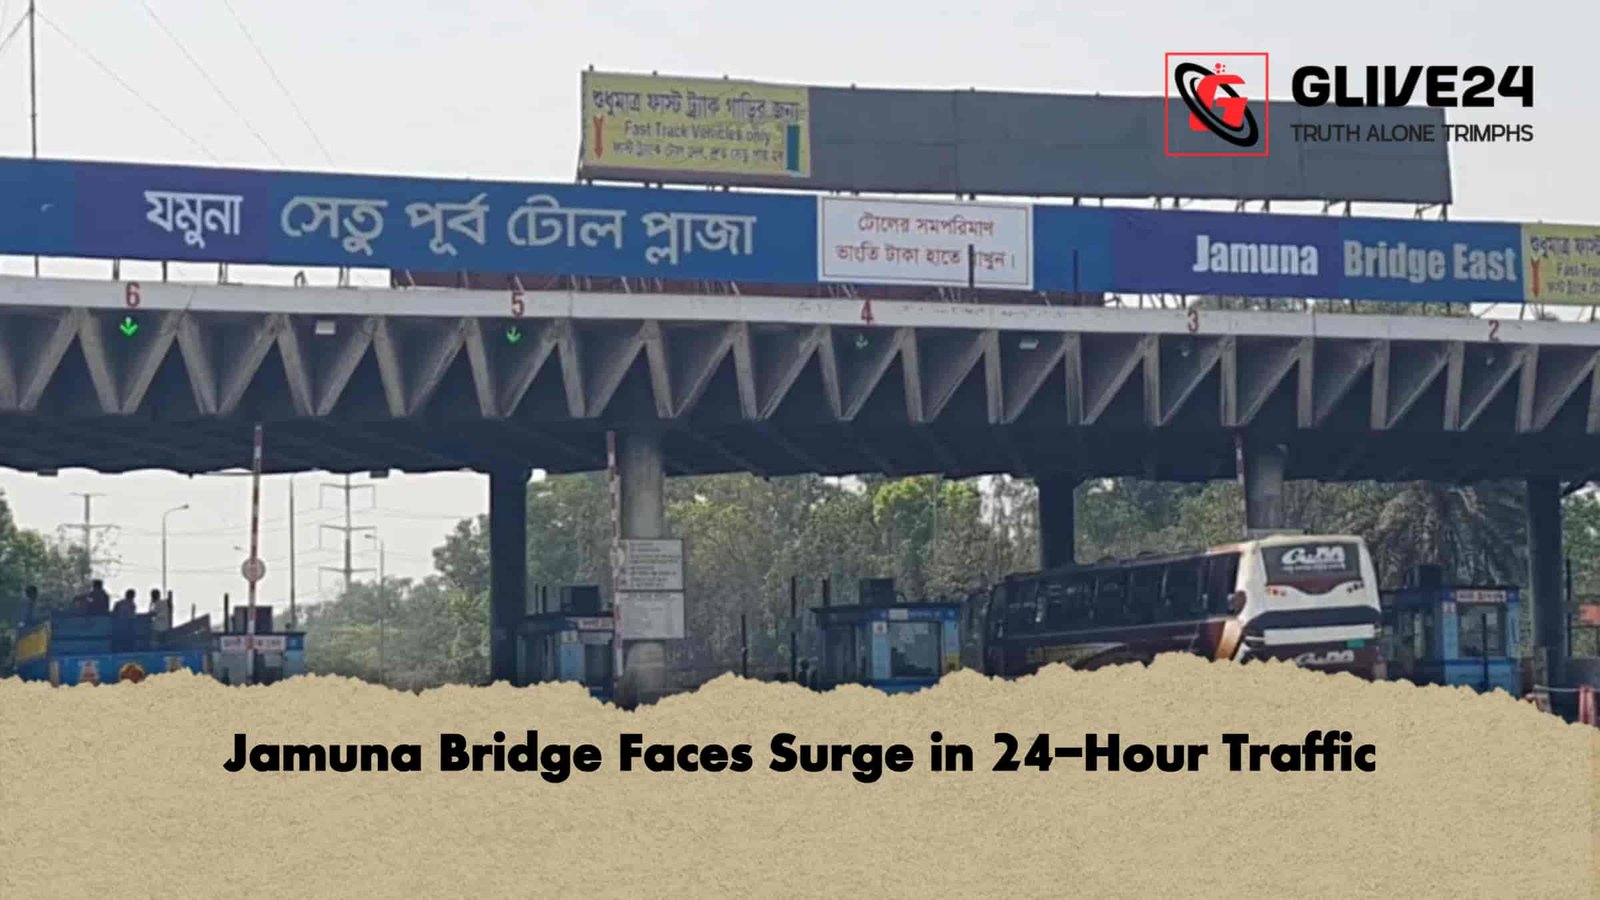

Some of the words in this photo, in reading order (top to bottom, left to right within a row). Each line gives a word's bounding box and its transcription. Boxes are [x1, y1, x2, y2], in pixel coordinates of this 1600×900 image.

[624, 120, 652, 136] Fast
[655, 121, 688, 138] Track
[692, 124, 742, 142] Vehicles
[144, 190, 244, 249] যমুনা
[281, 196, 388, 256] সেতু
[404, 193, 490, 256] পূর্ব
[507, 194, 627, 249] টোল
[641, 211, 757, 265] প্লাজা
[858, 211, 910, 233] টোলের
[884, 243, 919, 264] টাকা
[926, 248, 962, 266] হাতে
[1193, 235, 1320, 276] Jamuna
[1343, 239, 1446, 283] Bridge
[1453, 244, 1518, 282] East
[125, 282, 141, 308] 6
[511, 291, 525, 317] 5
[861, 299, 874, 325] 4
[1187, 310, 1199, 333] 3
[1488, 320, 1500, 341] 2
